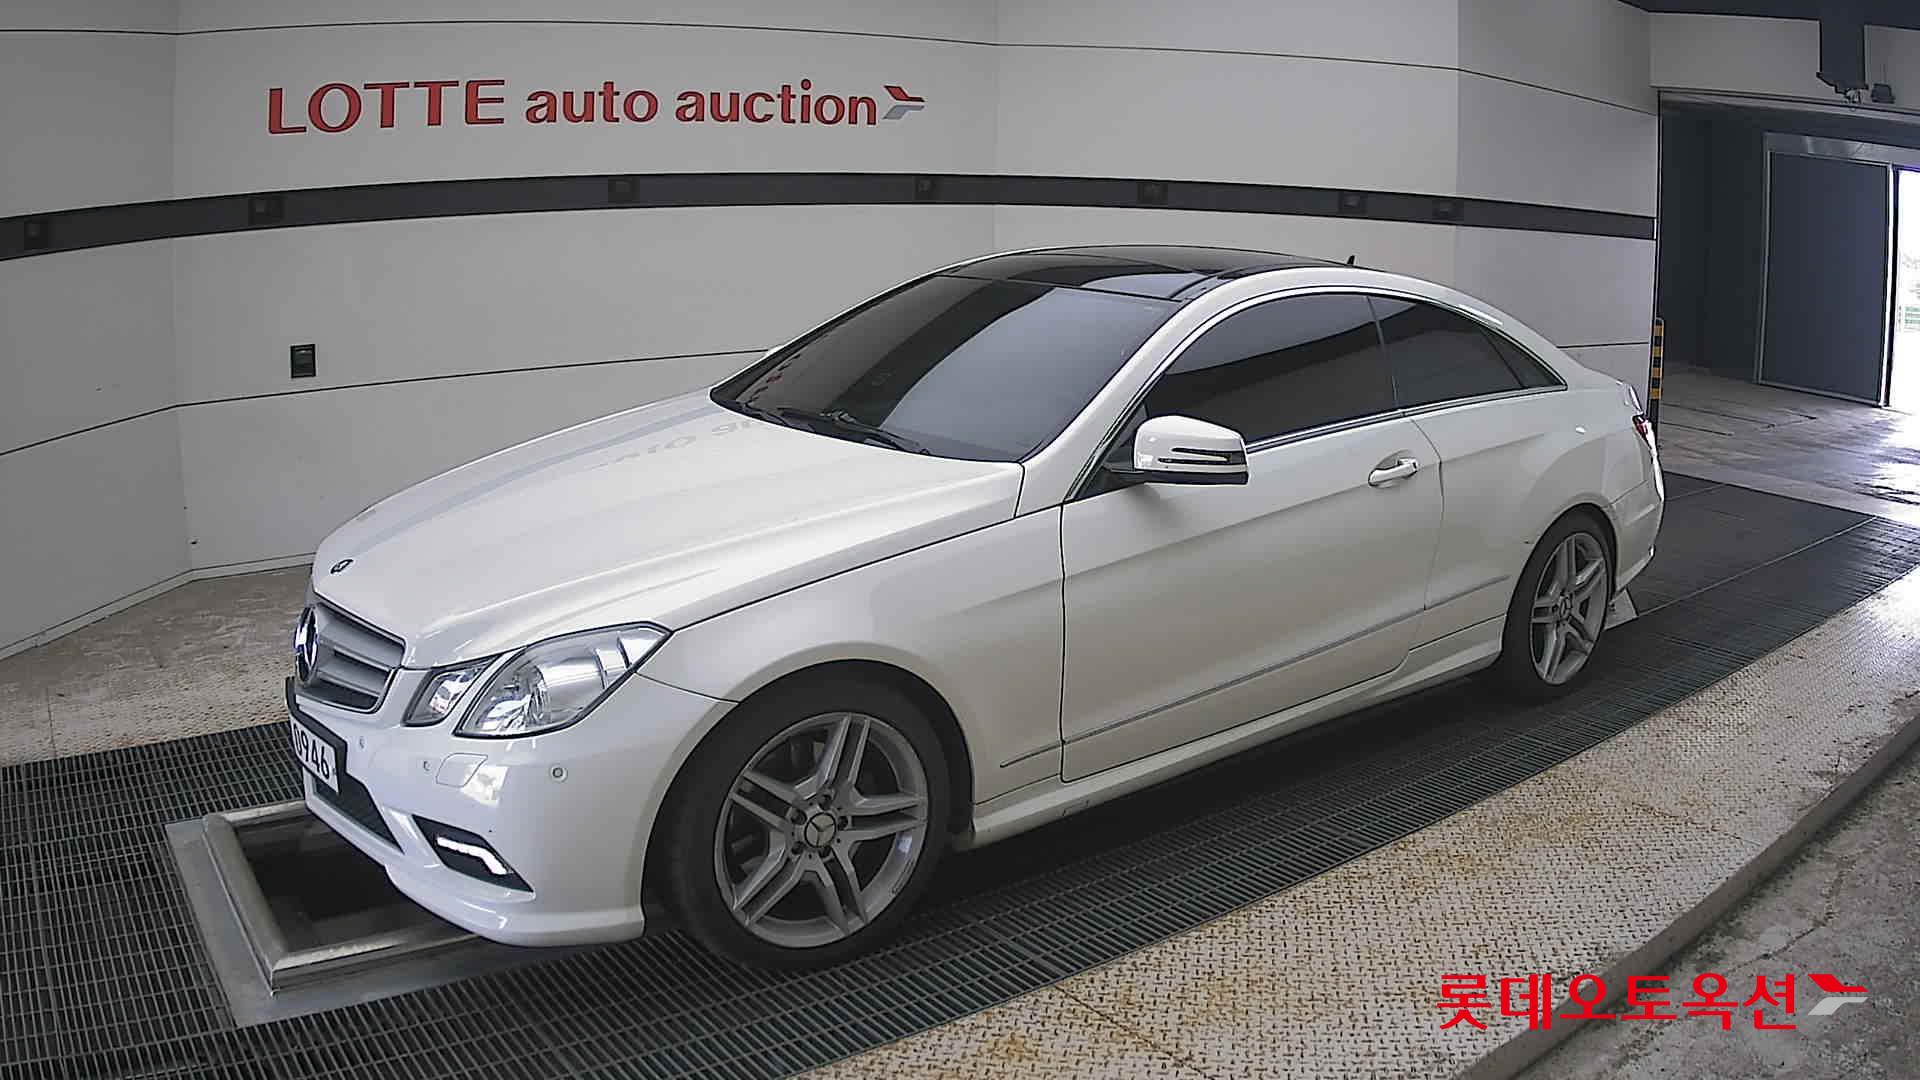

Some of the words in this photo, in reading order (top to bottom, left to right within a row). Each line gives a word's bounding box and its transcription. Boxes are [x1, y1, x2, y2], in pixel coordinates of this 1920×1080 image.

[268, 79, 505, 134] LOTTE
[525, 81, 658, 124] auto
[675, 79, 877, 125] auction
[293, 722, 330, 780] 0946
